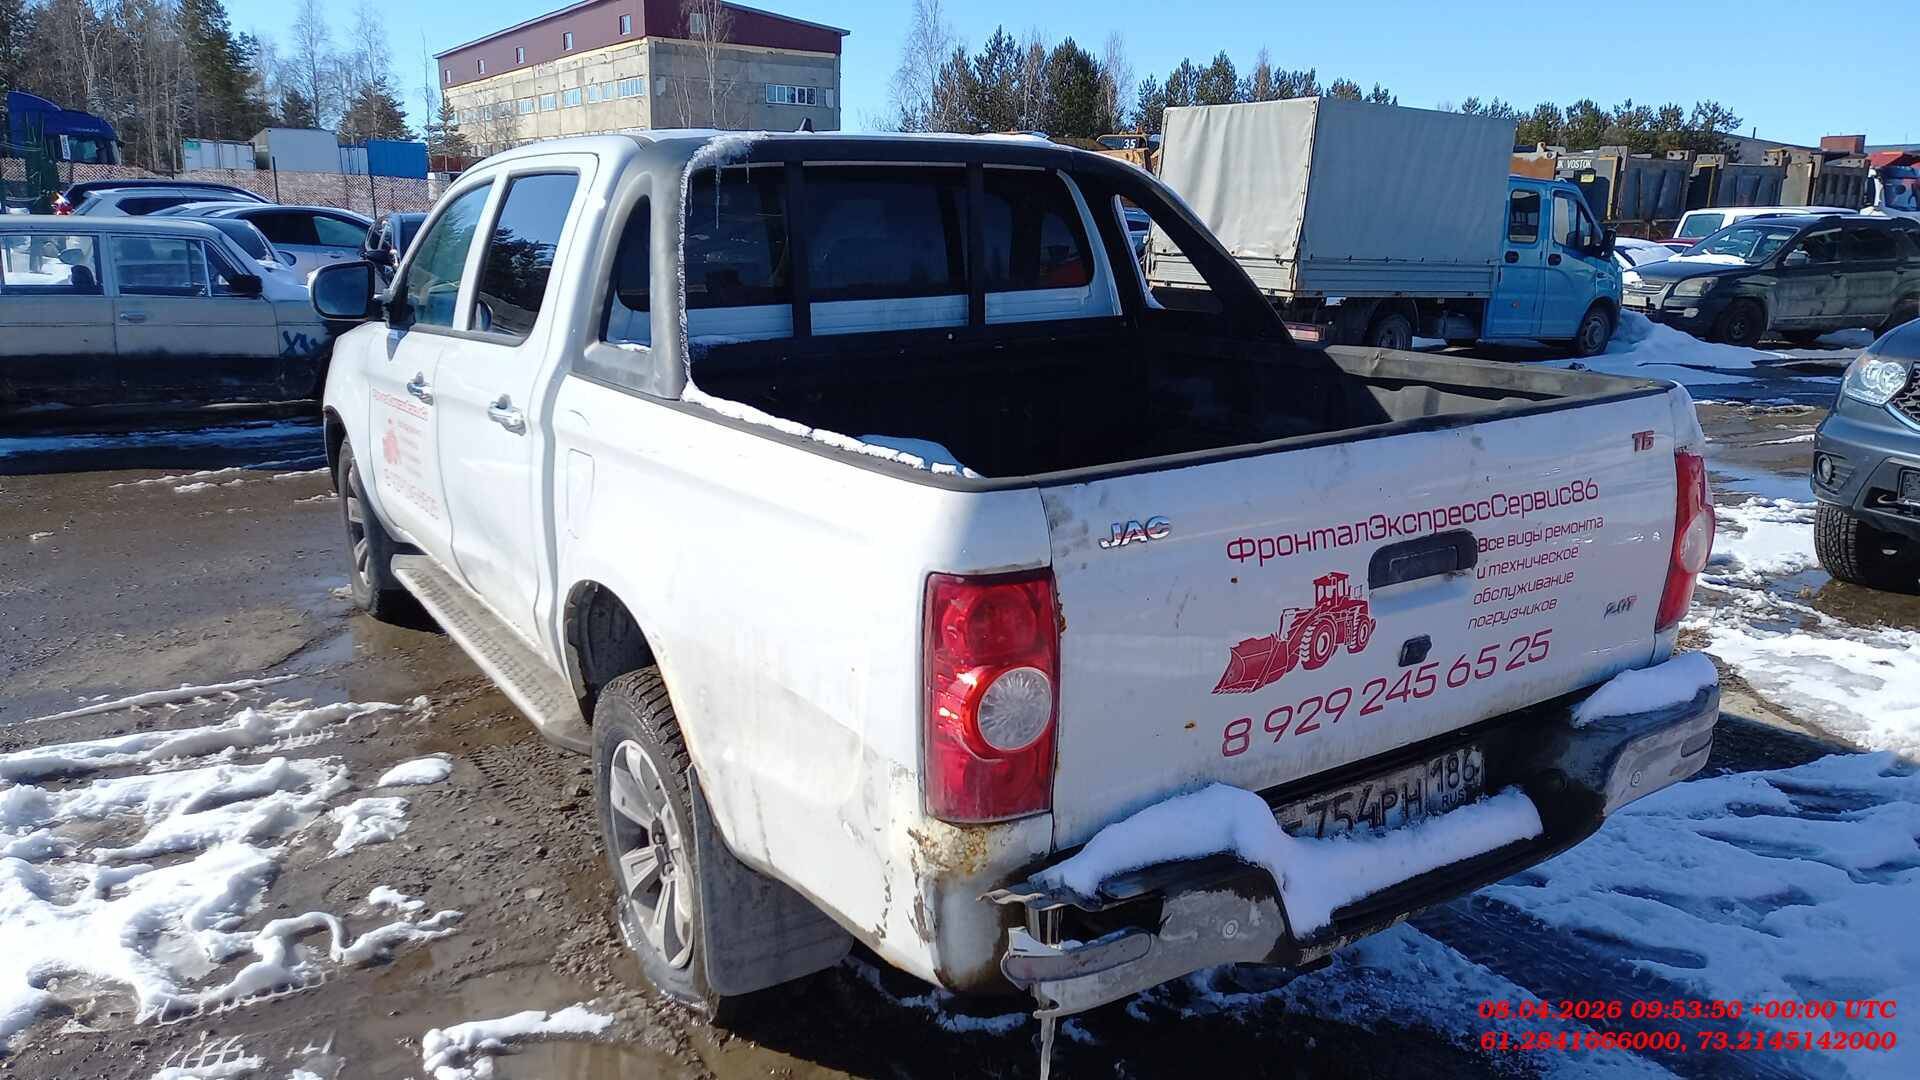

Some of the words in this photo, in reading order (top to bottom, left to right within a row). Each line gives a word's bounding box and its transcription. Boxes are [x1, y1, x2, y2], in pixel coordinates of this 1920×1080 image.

[1123, 138, 1137, 149] 35
[1567, 159, 1592, 169] VOSTOK
[1099, 515, 1170, 549] JAC
[1226, 477, 1600, 567] ФронталЭкспрессСервис86
[1477, 536, 1505, 553] Все
[1507, 531, 1543, 547] виды
[1545, 516, 1604, 543] ремонта
[1476, 566, 1486, 580] и
[1488, 546, 1580, 577] техническое
[1473, 571, 1575, 605] обслуживание
[1467, 598, 1558, 630] погрузчиков
[1220, 716, 1251, 758] 8
[1263, 685, 1354, 744] 929
[1359, 661, 1439, 718] 245
[1446, 643, 1499, 687] 65
[1503, 628, 1554, 673] 25
[1441, 788, 1467, 806] RUS
